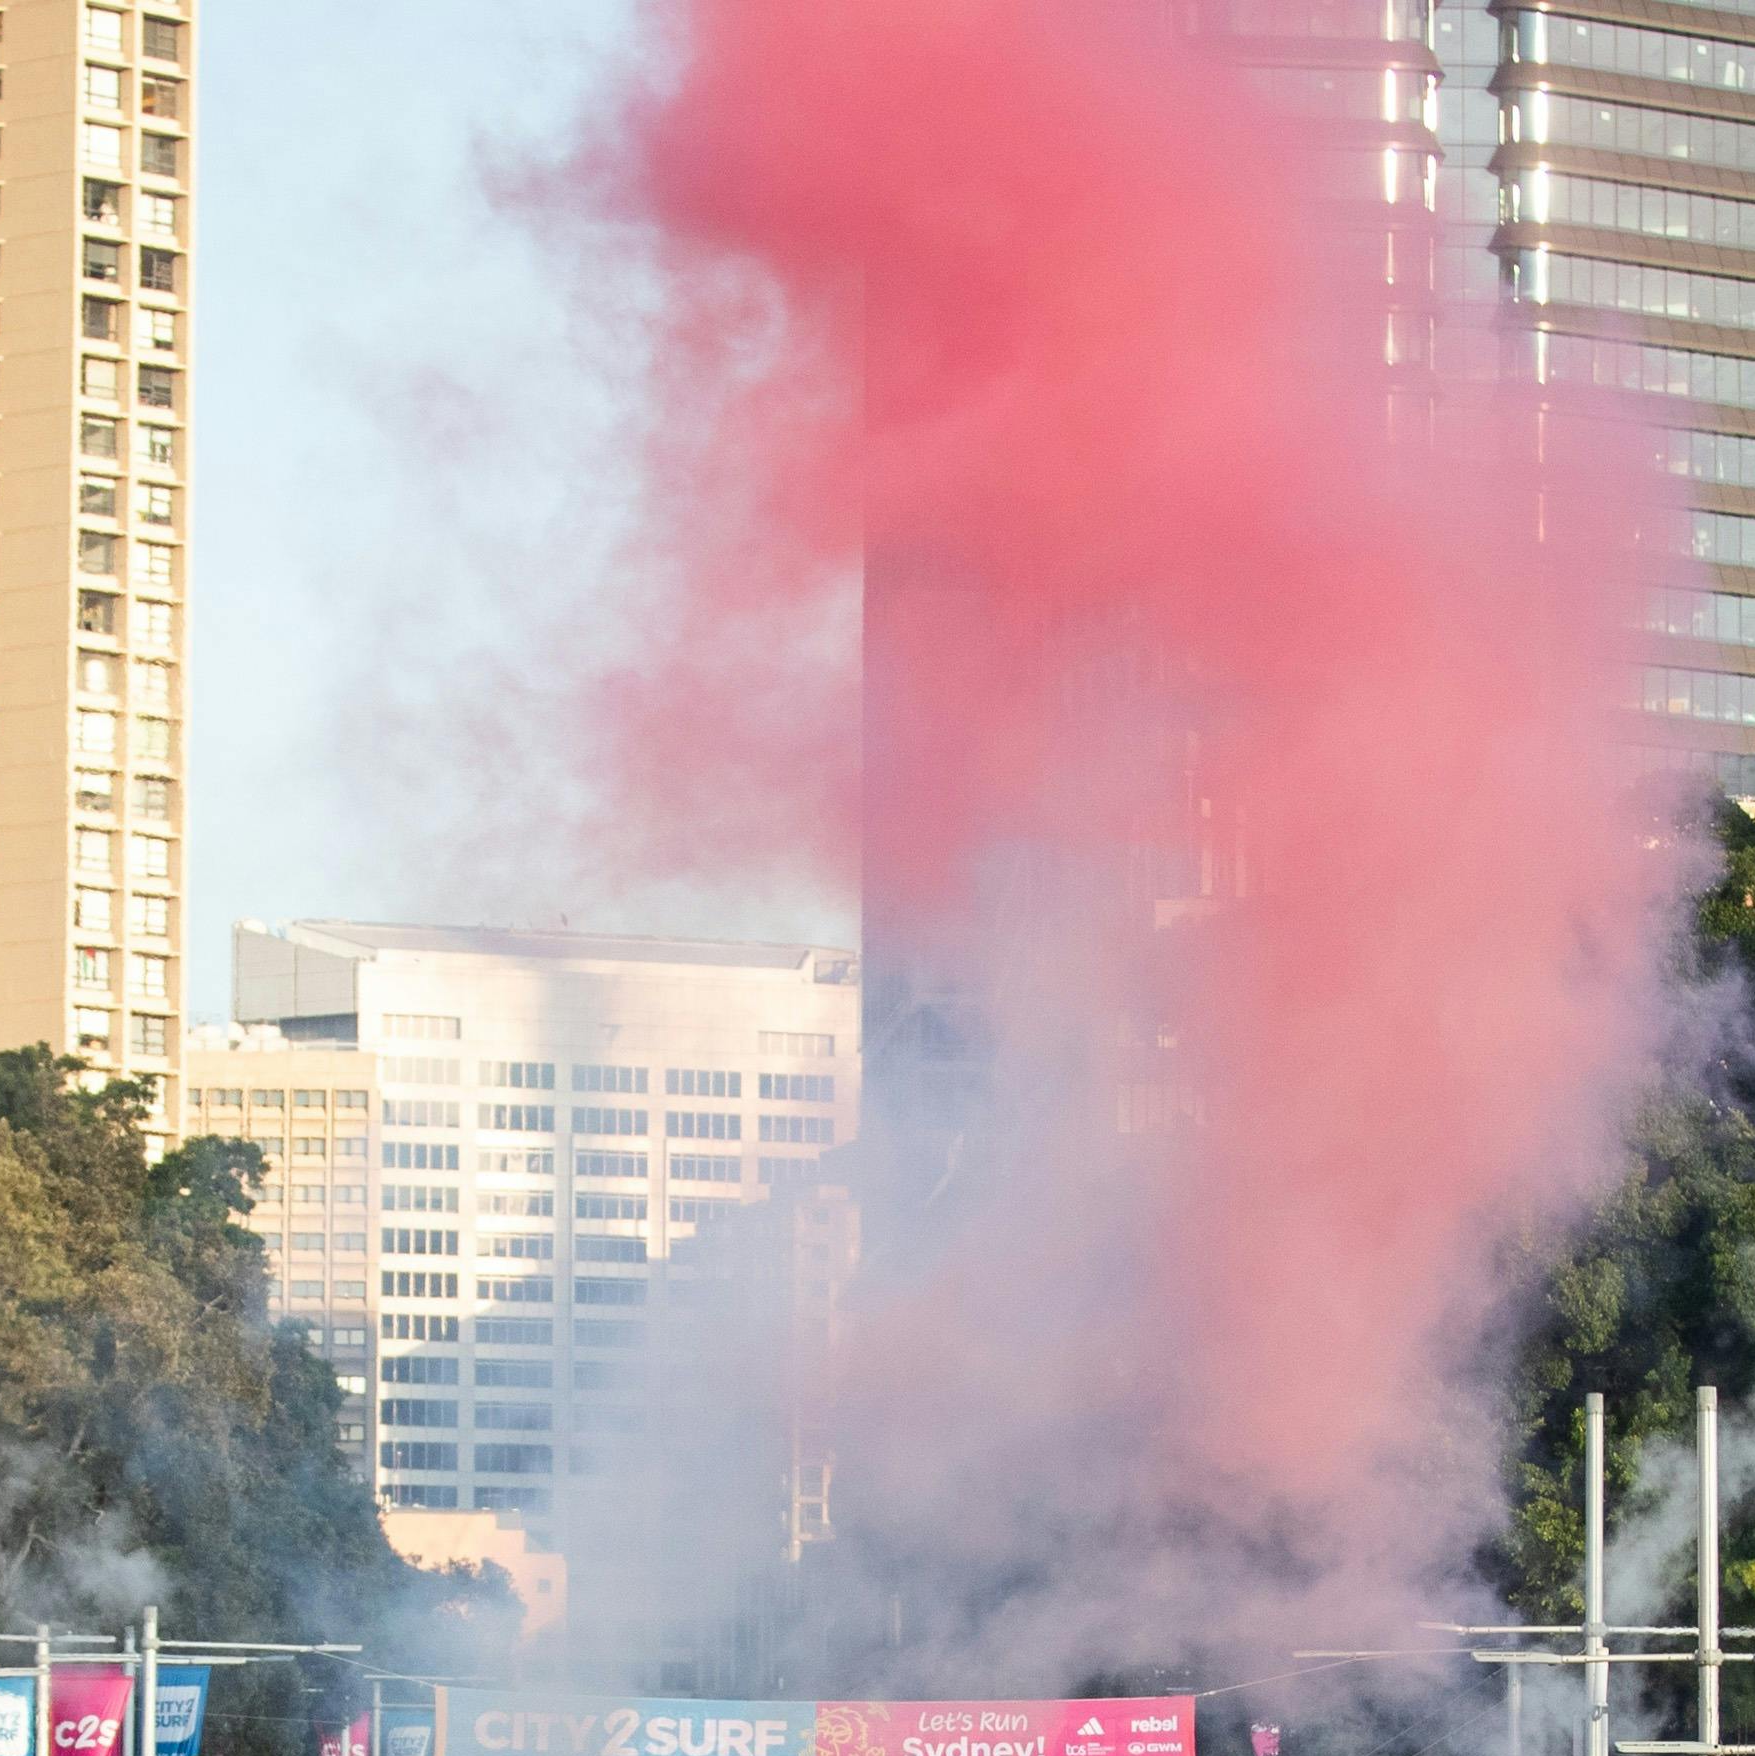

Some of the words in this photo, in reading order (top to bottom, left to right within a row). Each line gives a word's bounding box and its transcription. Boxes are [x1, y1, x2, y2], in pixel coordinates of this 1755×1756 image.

[155, 1698, 195, 1713] ITY2
[918, 1711, 973, 1732] Let's
[979, 1711, 1028, 1732] Run
[1130, 1716, 1178, 1733] rebel
[1146, 1742, 1183, 1752] GWM
